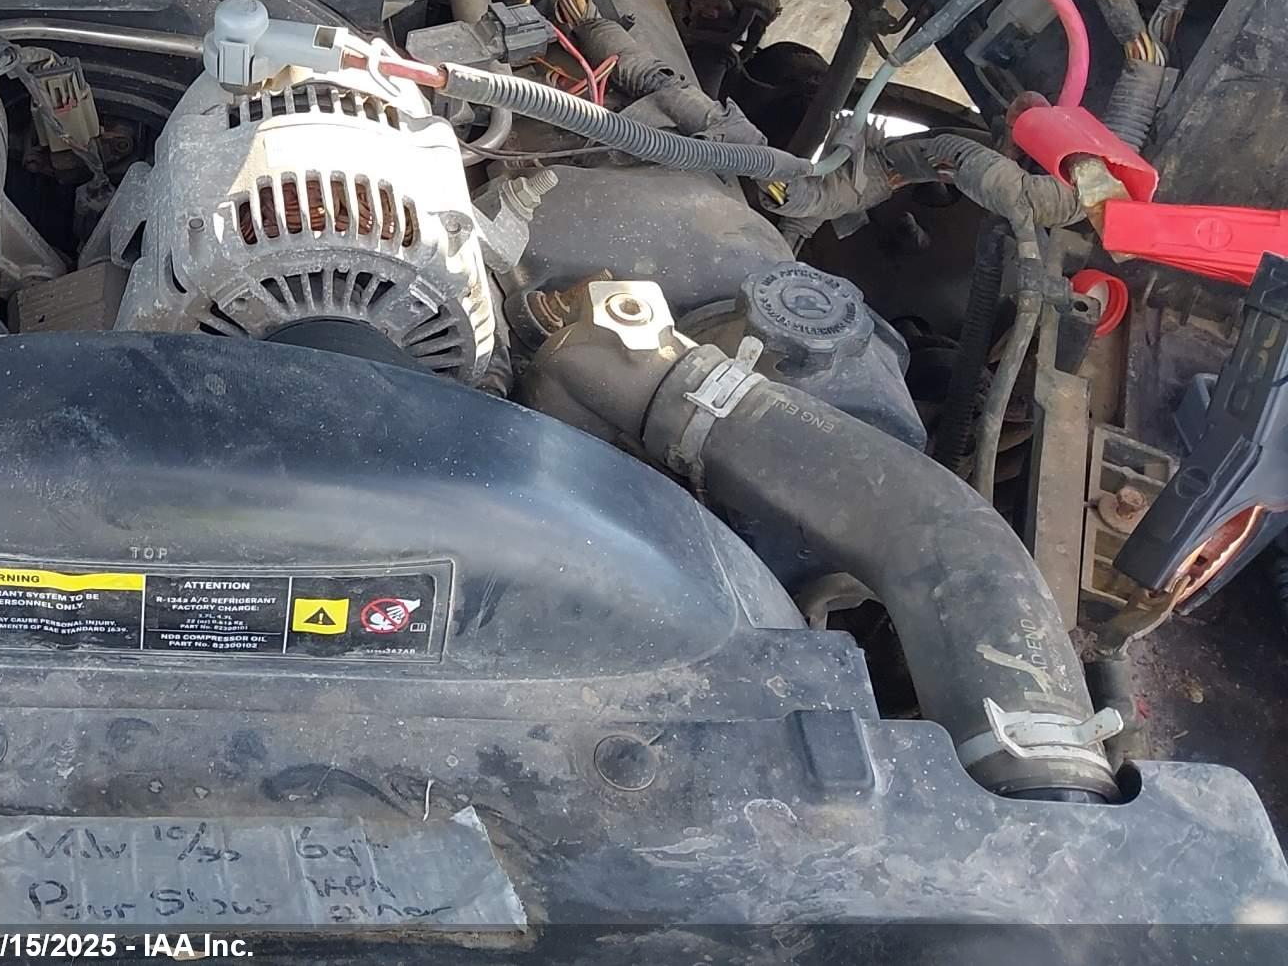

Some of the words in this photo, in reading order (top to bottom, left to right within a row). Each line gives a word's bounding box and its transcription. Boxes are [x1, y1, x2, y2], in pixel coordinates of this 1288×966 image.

[800, 411, 834, 433] ENG
[129, 546, 168, 559] TOP
[183, 581, 251, 590] ATTENTION
[26, 591, 68, 601] SYSTEM
[69, 594, 83, 602] TO
[85, 593, 100, 601] BE
[210, 597, 277, 605] REFRIGERANT
[55, 601, 86, 611] ONLY.
[217, 604, 260, 612] CHARGE:
[39, 618, 84, 627] PERSONAL
[43, 625, 59, 634] SAE
[60, 625, 106, 635] STANDARD
[182, 633, 249, 642] COMPRESSOR
[212, 641, 258, 649] 82300102
